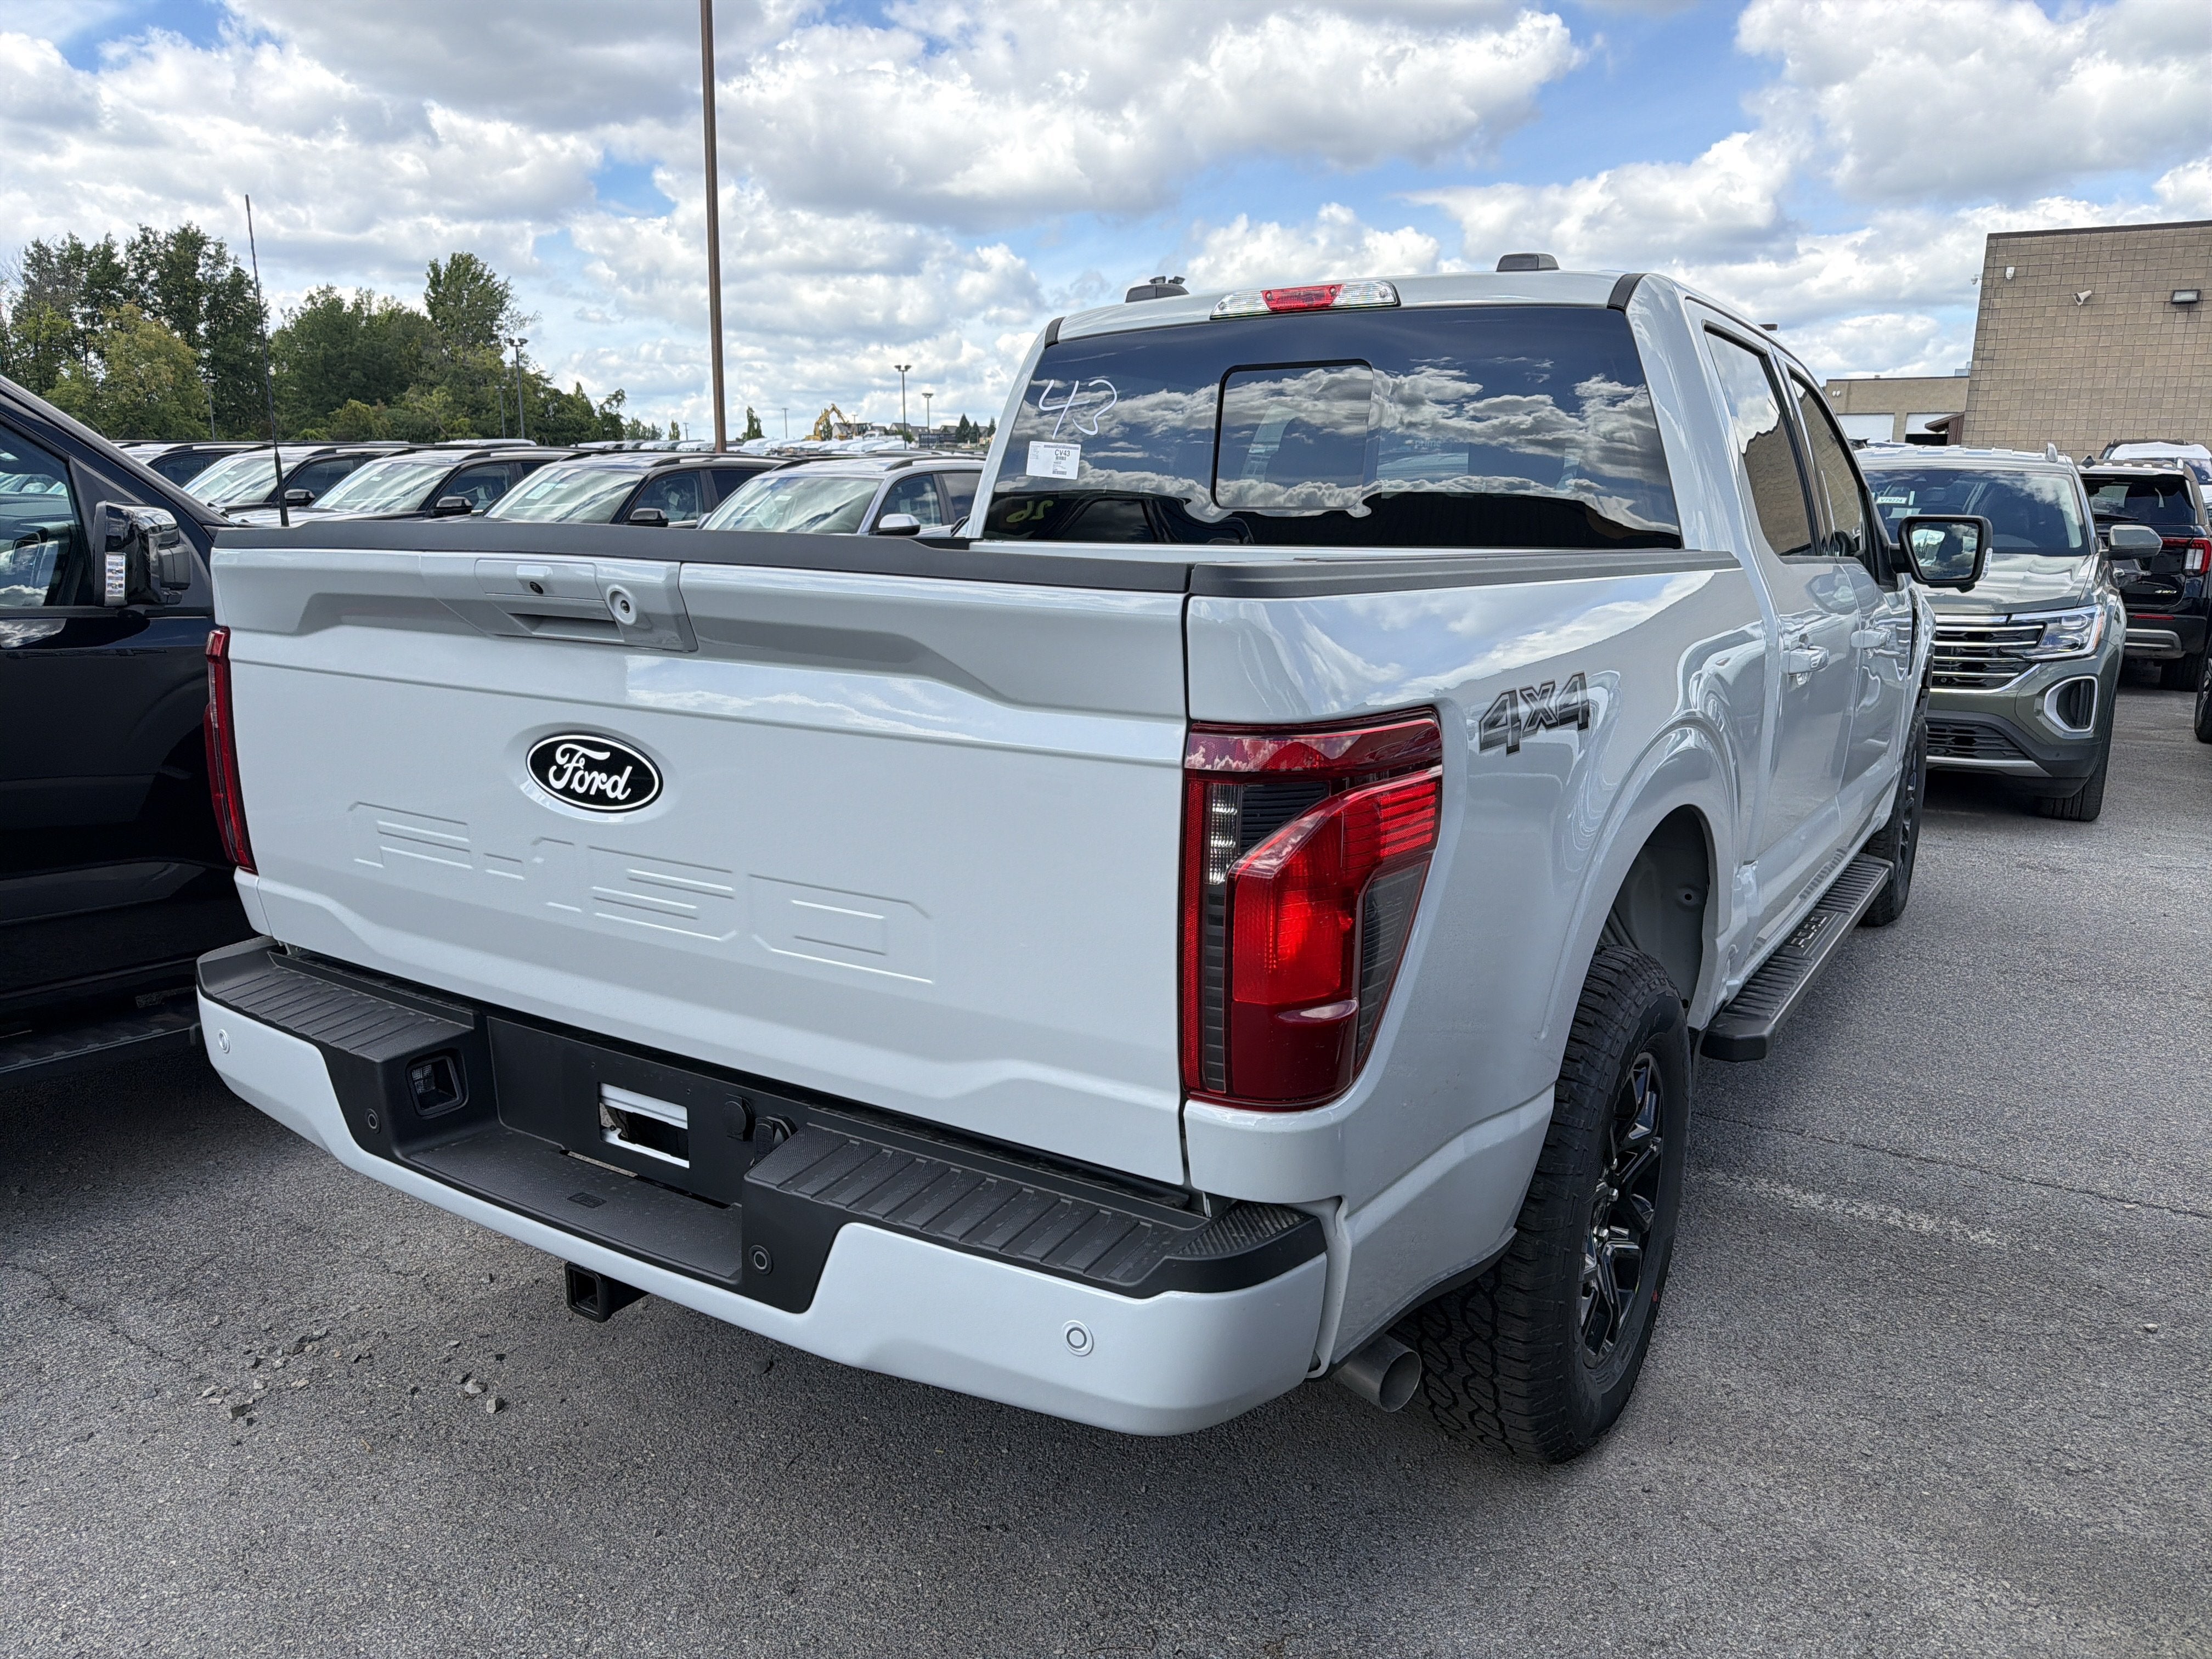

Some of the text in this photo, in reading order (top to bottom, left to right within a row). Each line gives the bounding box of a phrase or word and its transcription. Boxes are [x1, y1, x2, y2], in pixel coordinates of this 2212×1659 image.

[1038, 379, 1118, 440] 43
[549, 743, 633, 800] Ford
[348, 800, 935, 984] F-150
